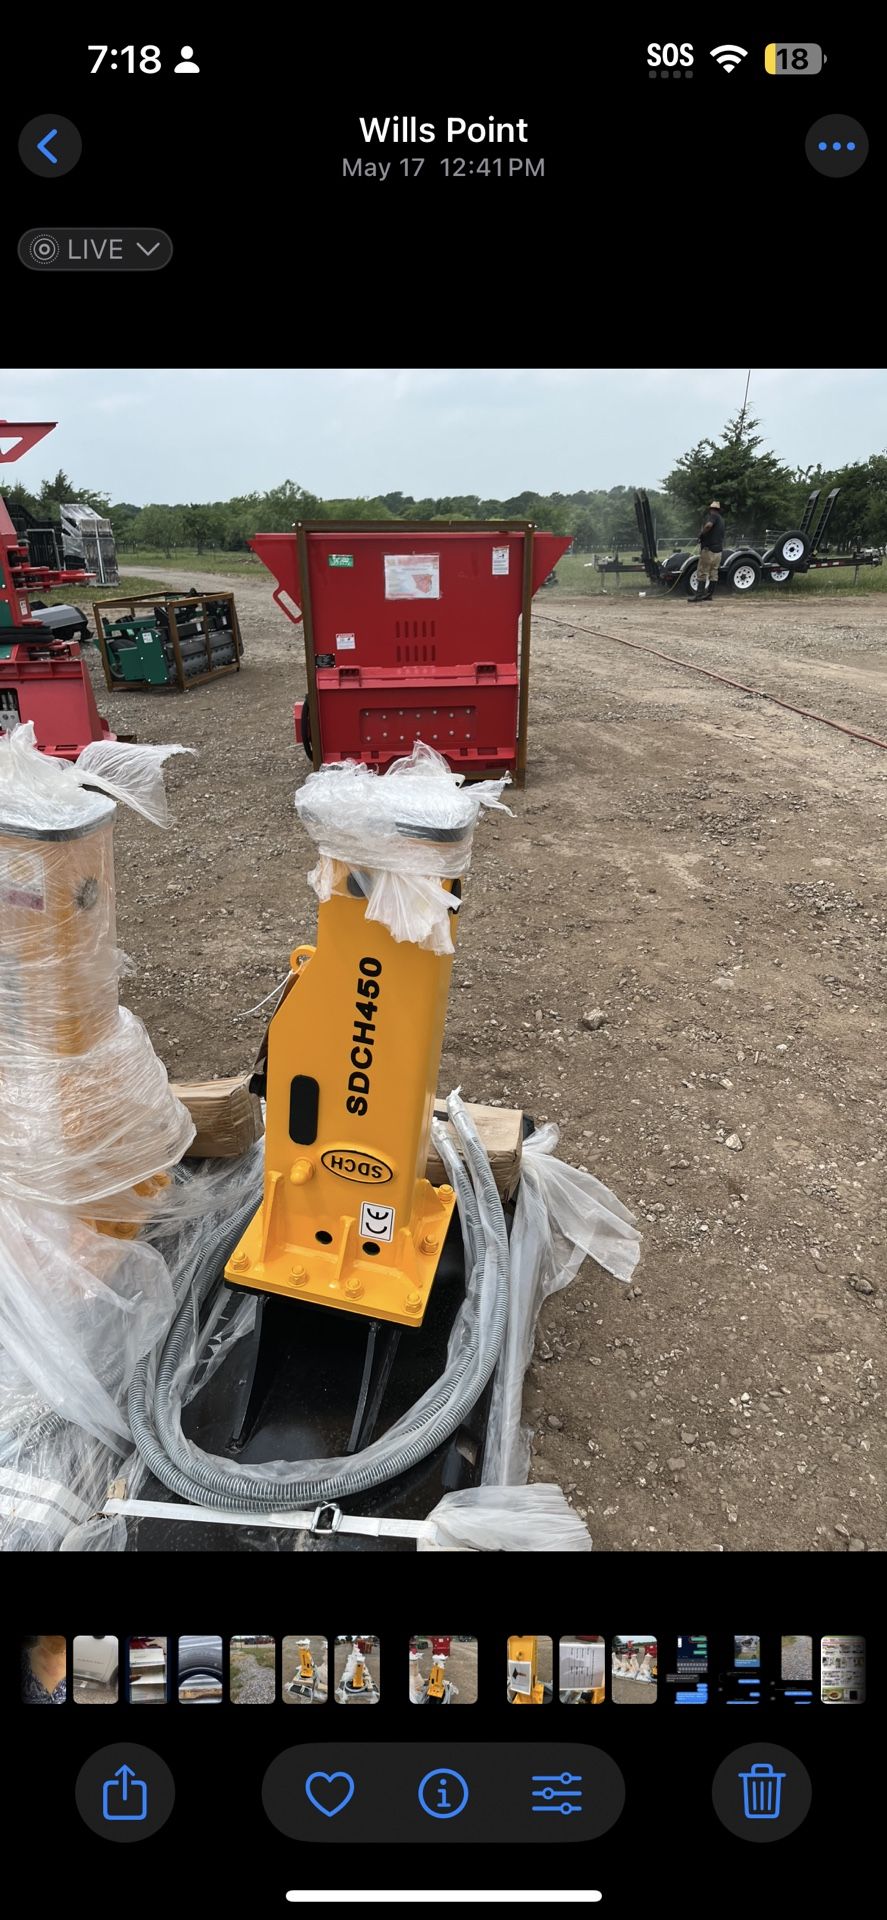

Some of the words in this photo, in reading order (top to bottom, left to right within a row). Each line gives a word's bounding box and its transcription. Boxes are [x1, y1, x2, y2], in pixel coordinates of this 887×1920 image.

[346, 956, 383, 1117] SDCH450
[330, 1155, 383, 1179] SDCH
[366, 1207, 389, 1234] CE
